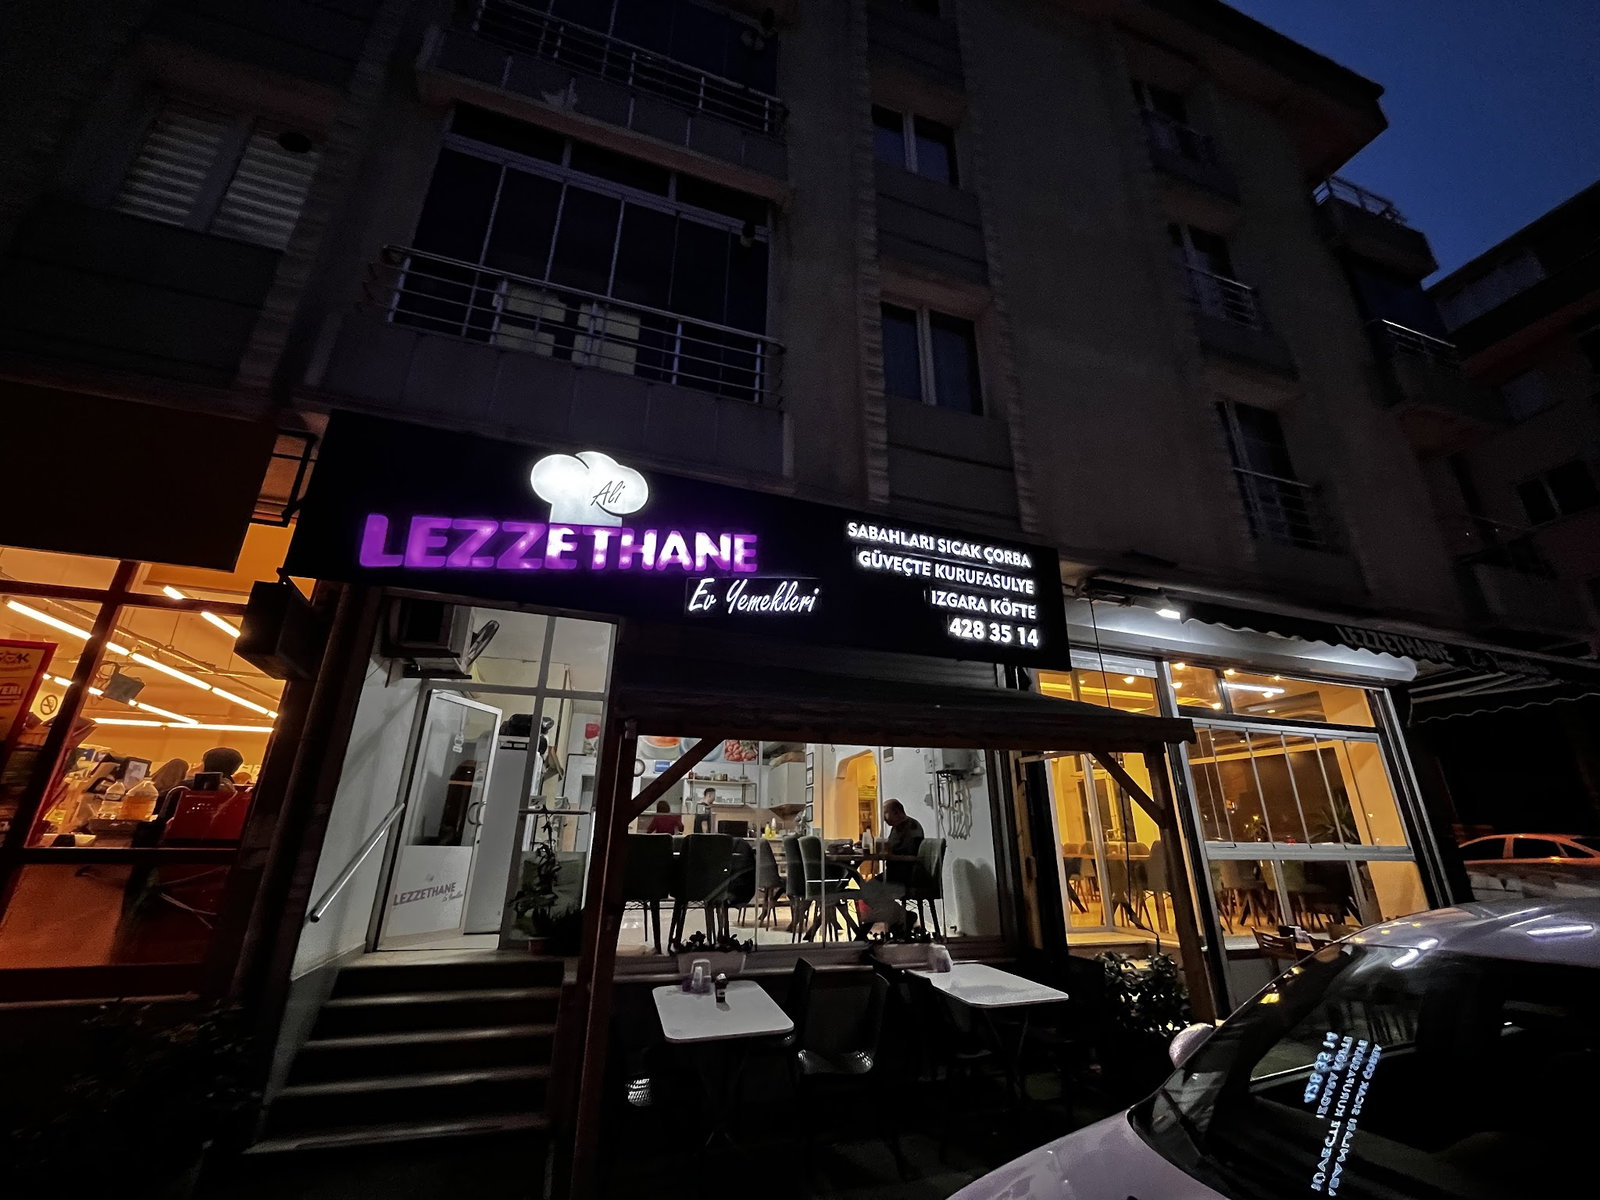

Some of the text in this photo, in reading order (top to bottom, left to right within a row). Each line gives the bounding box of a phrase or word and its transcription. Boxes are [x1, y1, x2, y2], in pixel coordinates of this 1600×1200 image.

[590, 480, 626, 506] Ali
[359, 513, 758, 573] LEZZETHANE
[847, 521, 1032, 569] SABAHLARI SICAK ÇORBA
[858, 550, 1035, 595] GÜVEÇTE KURUFASULYE
[688, 577, 820, 614] Ev Yemekleri
[931, 589, 1037, 620] IZGARA KÖFTE
[949, 617, 1039, 647] 428 35 14
[393, 882, 457, 907] LEZZETHANE
